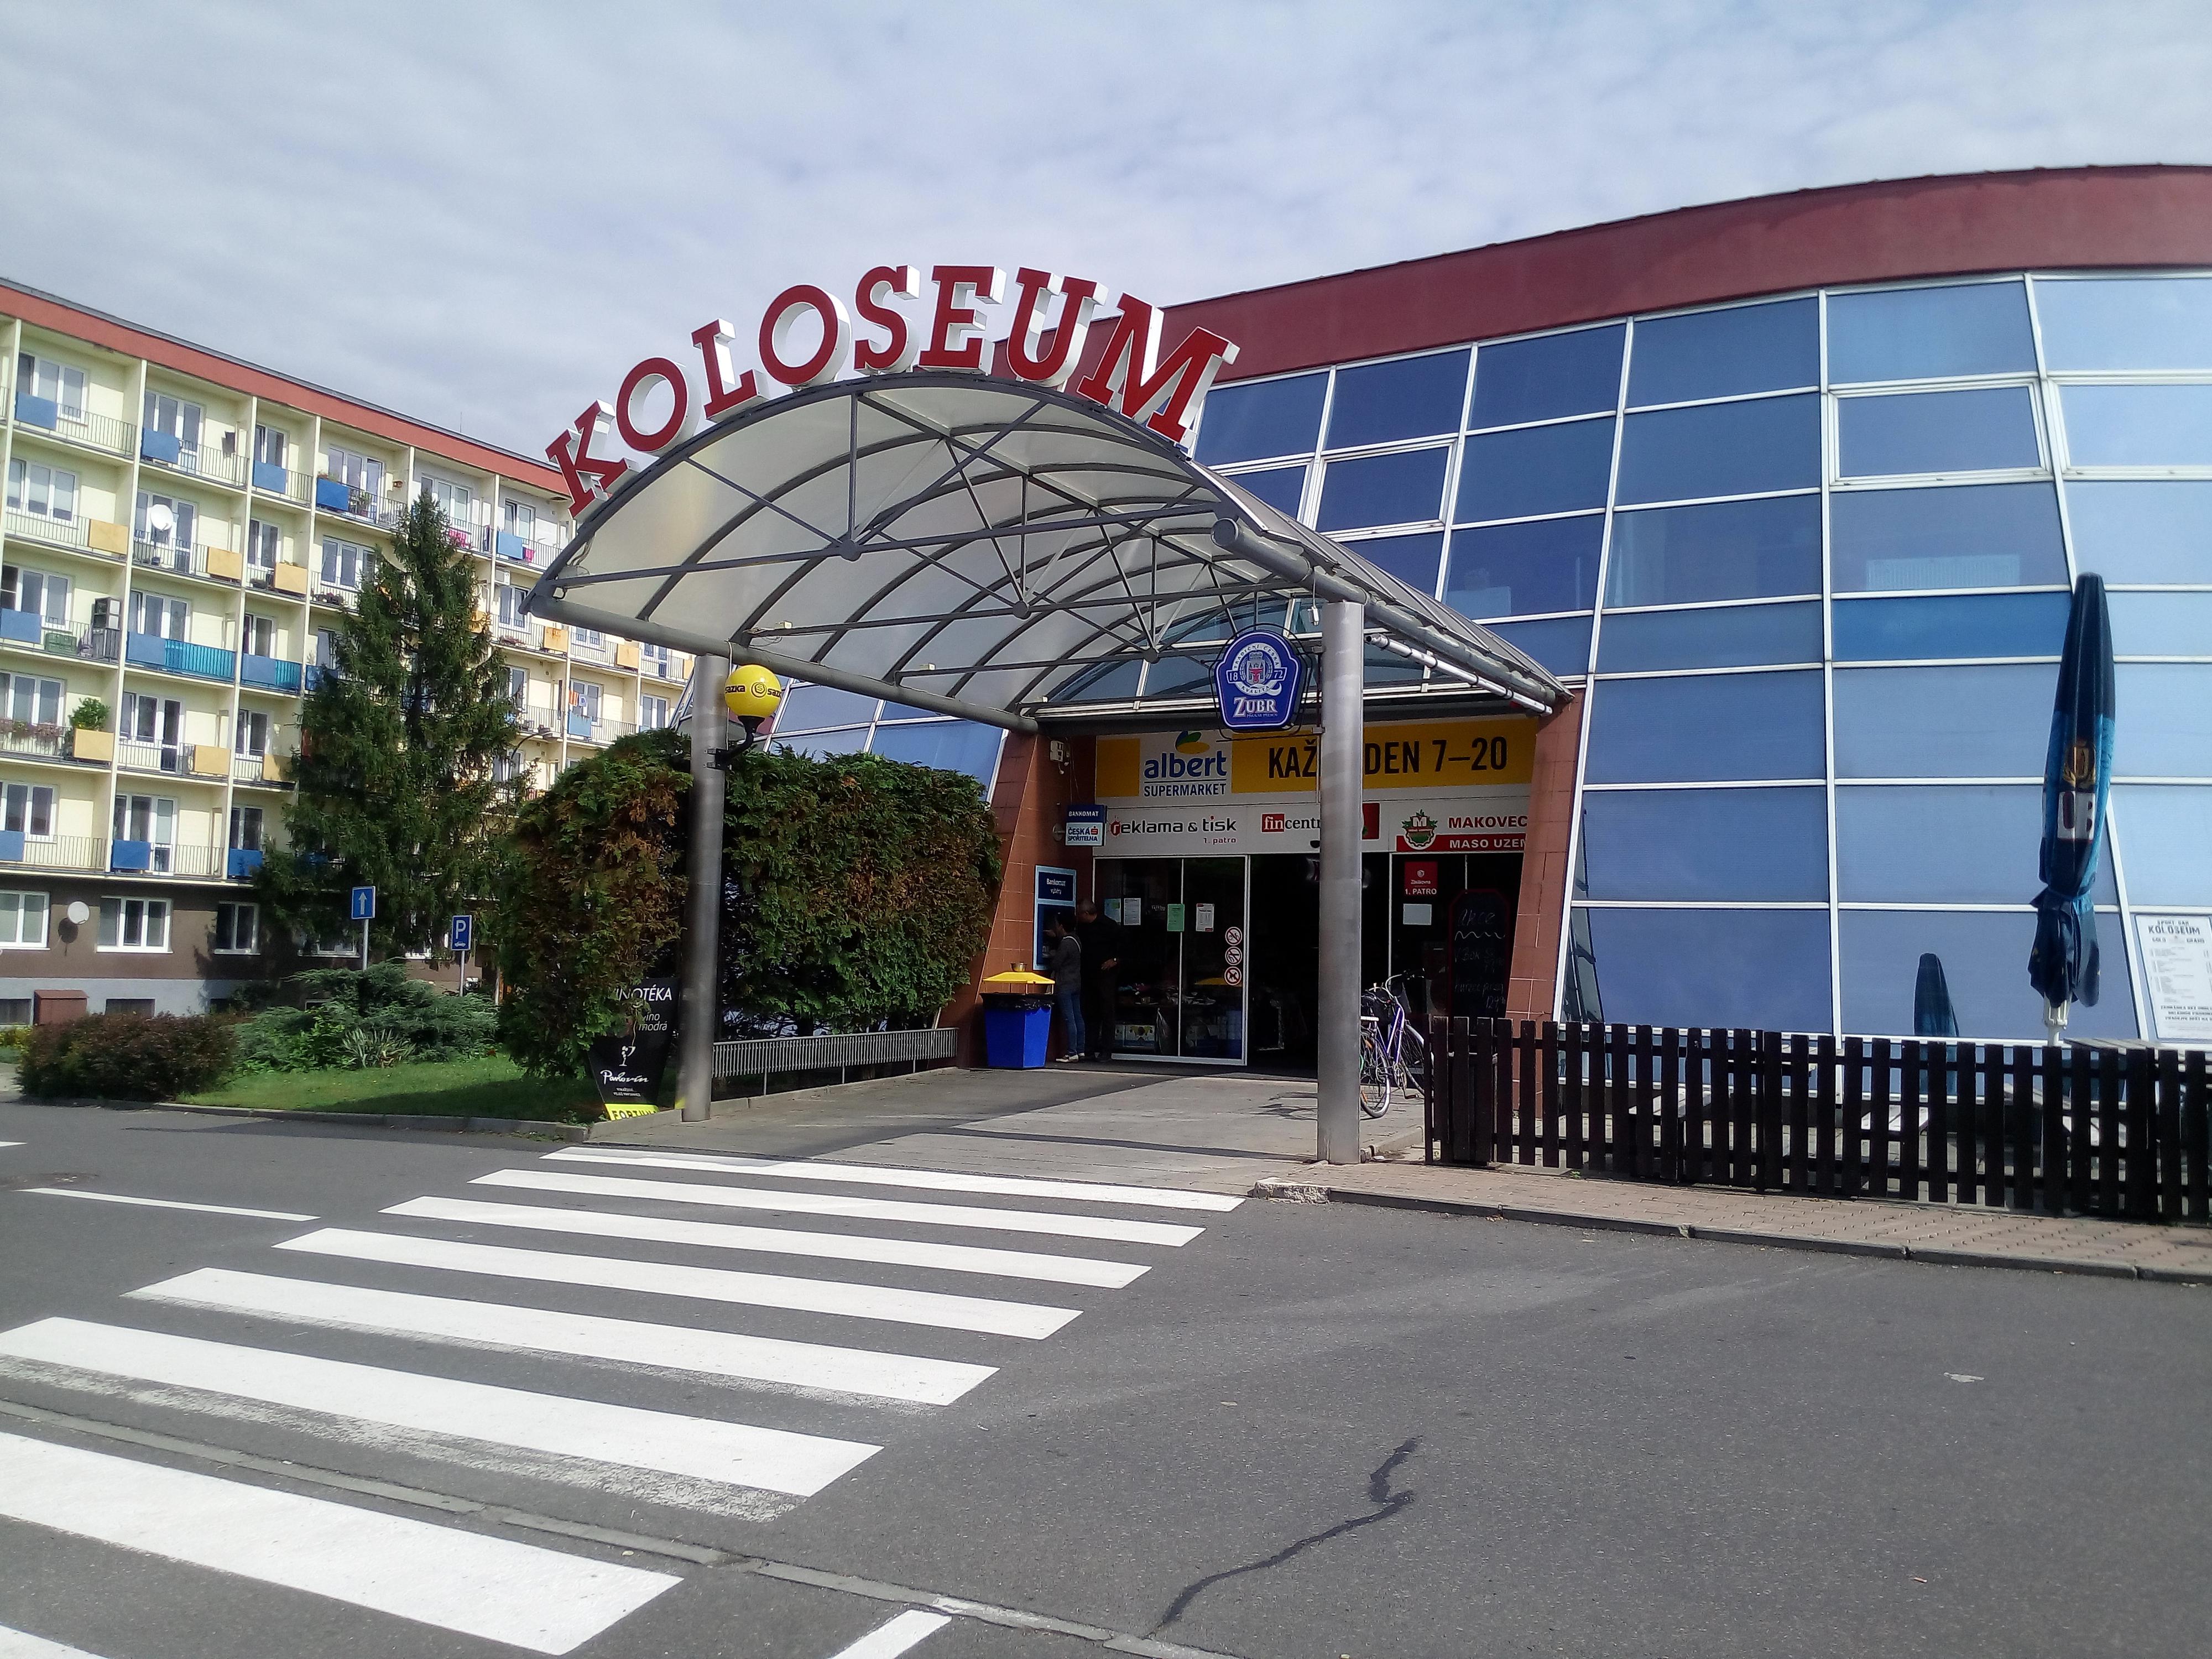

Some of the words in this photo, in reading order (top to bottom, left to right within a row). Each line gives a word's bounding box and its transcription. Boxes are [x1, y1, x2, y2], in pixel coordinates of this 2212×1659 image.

[546, 265, 1240, 521] KOLOSEUM
[1274, 670, 1283, 679] 72
[768, 688, 781, 697] saz
[1233, 697, 1278, 717] ZUBR
[1144, 750, 1227, 779] albert
[1269, 738, 1318, 779] KAŽ
[1364, 740, 1420, 775] DEN
[1144, 783, 1226, 797] SUPERMARKET
[1110, 820, 1183, 836] reklama
[1188, 822, 1198, 832] &
[1202, 815, 1237, 832] tisk
[1263, 816, 1320, 830] fincentr
[1448, 816, 1528, 828] MAKOVEC
[1068, 827, 1090, 835] ČESKÁ
[1213, 837, 1237, 846] patro
[1449, 839, 1489, 848] MASO
[1494, 838, 1525, 847] UZEN
[456, 920, 466, 939] P
[2148, 925, 2200, 935] KOLOSEUM
[616, 984, 672, 1001] INOTÉKA
